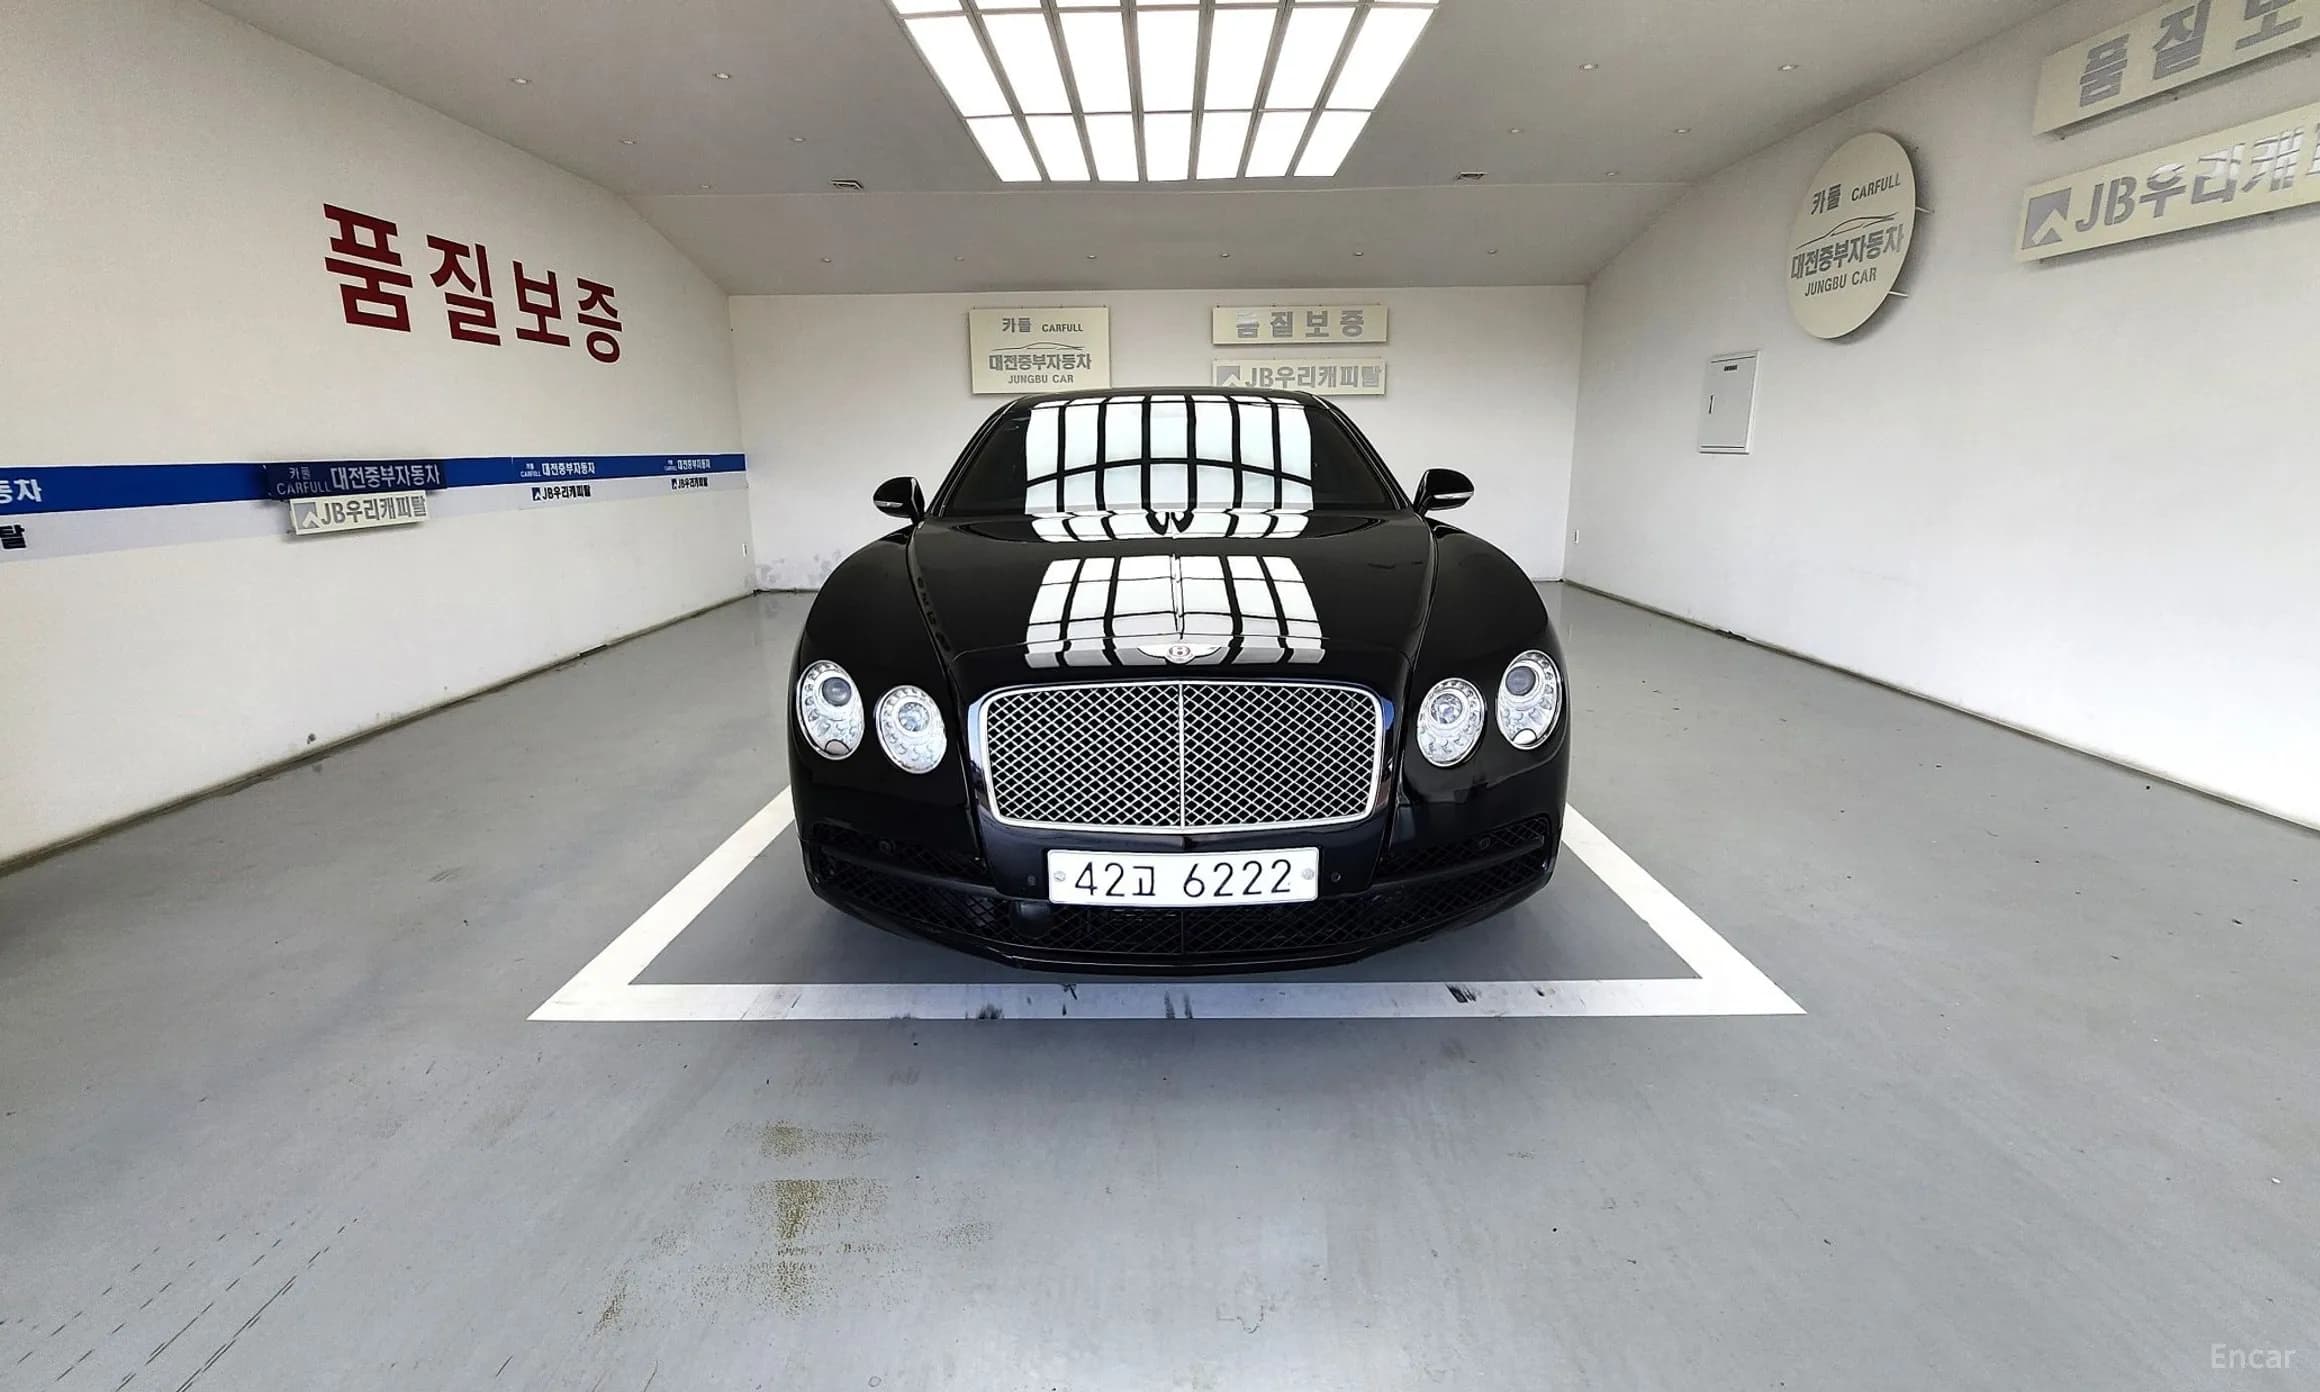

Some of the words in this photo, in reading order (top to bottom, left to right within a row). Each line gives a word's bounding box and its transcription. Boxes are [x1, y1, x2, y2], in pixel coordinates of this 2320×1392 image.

[1851, 172, 1901, 201] CARFULL
[2074, 122, 2320, 233] JB우리캐
[1790, 223, 1904, 280] 대전중부자동차
[323, 203, 624, 364] 품질보증
[1804, 274, 1847, 297] JUNGBU
[1851, 267, 1877, 285] CAR
[1041, 323, 1083, 332] CARFULL
[1236, 310, 1364, 338] 품질보증
[988, 353, 1092, 371] 대전중부자동차
[1008, 374, 1048, 384] JUNGBU
[1052, 374, 1074, 384] CAR
[1245, 366, 1382, 388] JB우리캐피탈
[276, 480, 331, 495] CARFULL
[330, 464, 441, 490] 대전중부자동차
[321, 496, 427, 526] JB우리캐피탈
[1075, 862, 1156, 897] 42고
[1183, 859, 1292, 898] 6222
